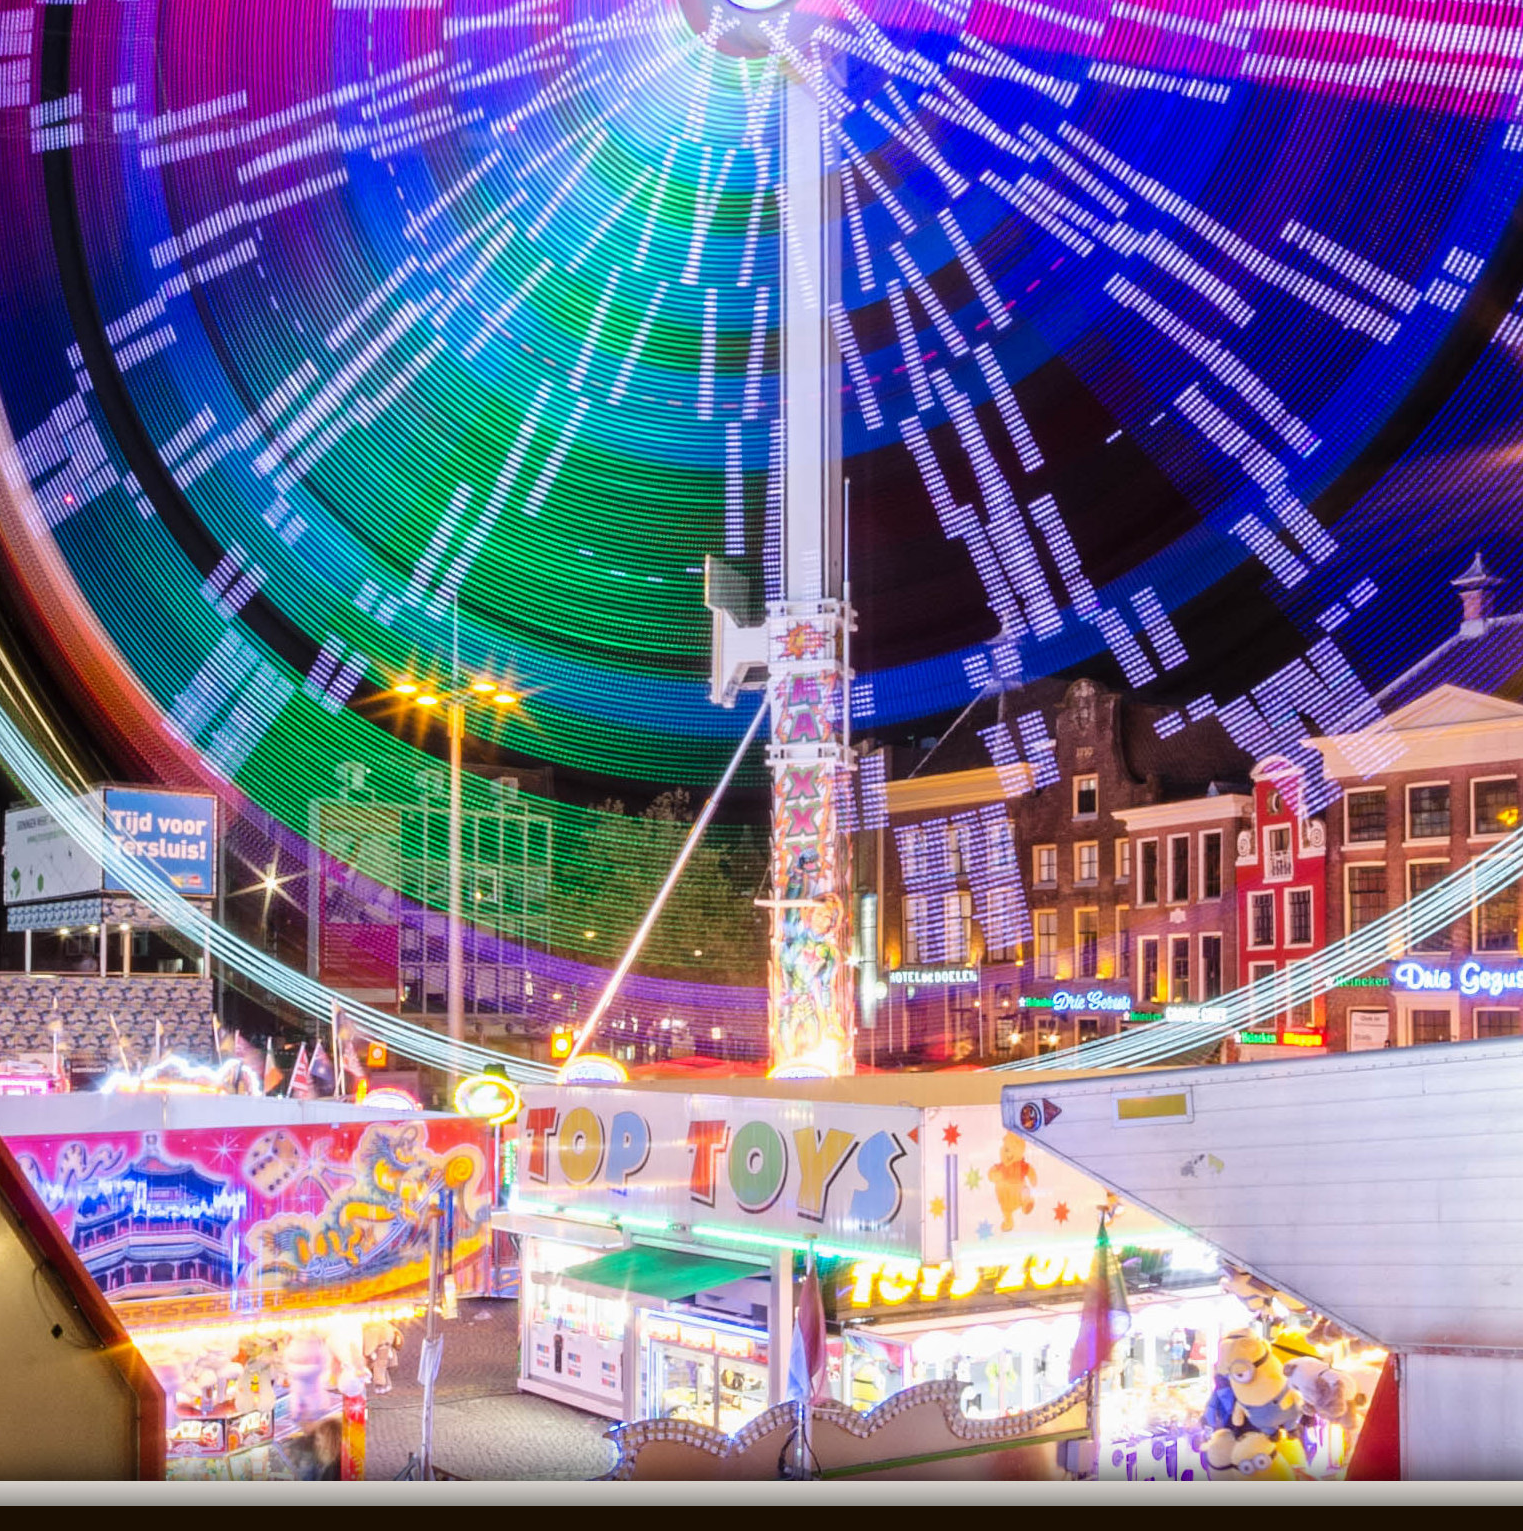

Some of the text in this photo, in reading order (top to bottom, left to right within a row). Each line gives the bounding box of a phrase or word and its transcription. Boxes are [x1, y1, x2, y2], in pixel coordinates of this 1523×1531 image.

[110, 809, 207, 836] Tijd voor
[890, 971, 921, 983] HOTEL
[1336, 975, 1390, 987] Heineken
[1395, 962, 1452, 990] Drie
[1053, 991, 1085, 1011] Drie
[526, 1106, 907, 1231] TOP TOYS
